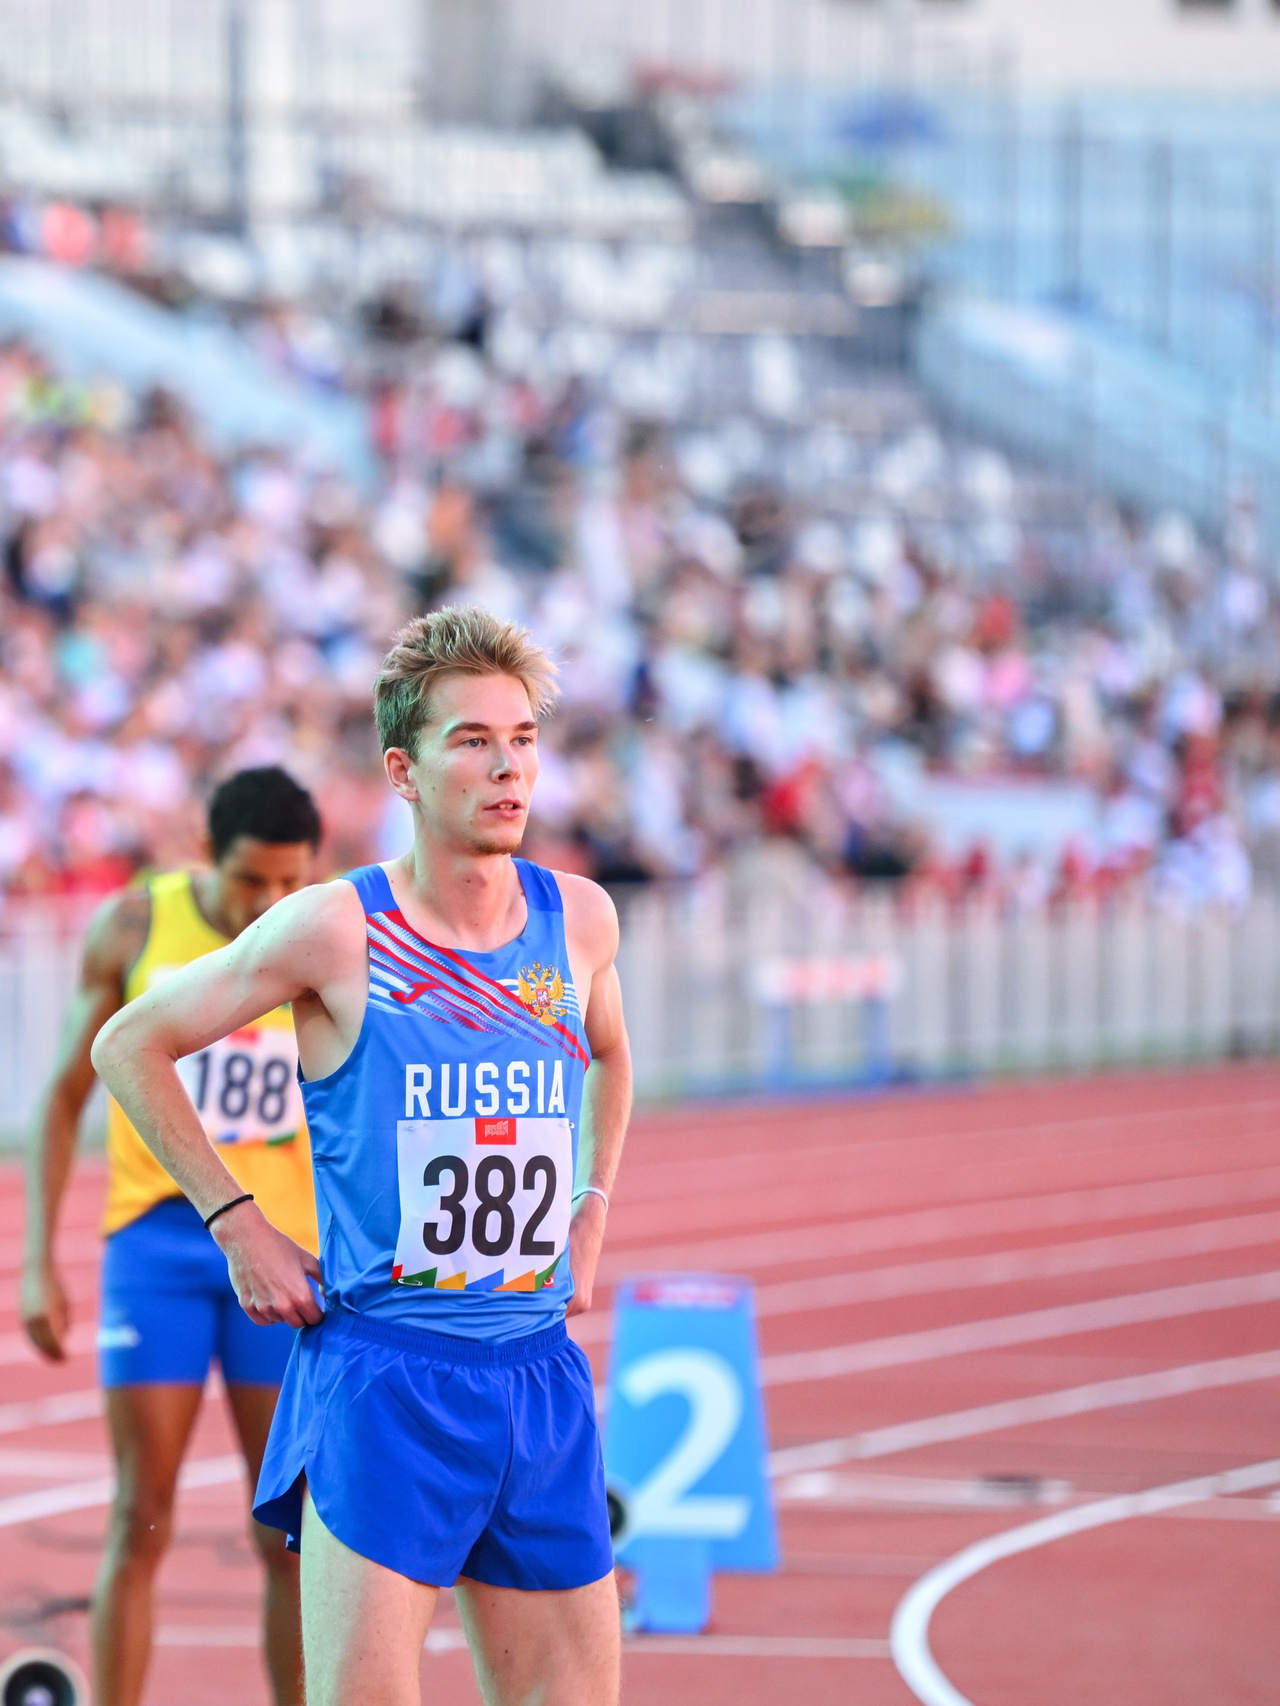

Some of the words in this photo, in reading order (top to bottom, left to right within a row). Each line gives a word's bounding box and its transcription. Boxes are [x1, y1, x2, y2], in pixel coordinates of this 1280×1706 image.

[194, 1050, 291, 1124] 188
[404, 1060, 566, 1118] RUSSIA
[422, 1154, 558, 1257] 382
[622, 1349, 751, 1540] 2
